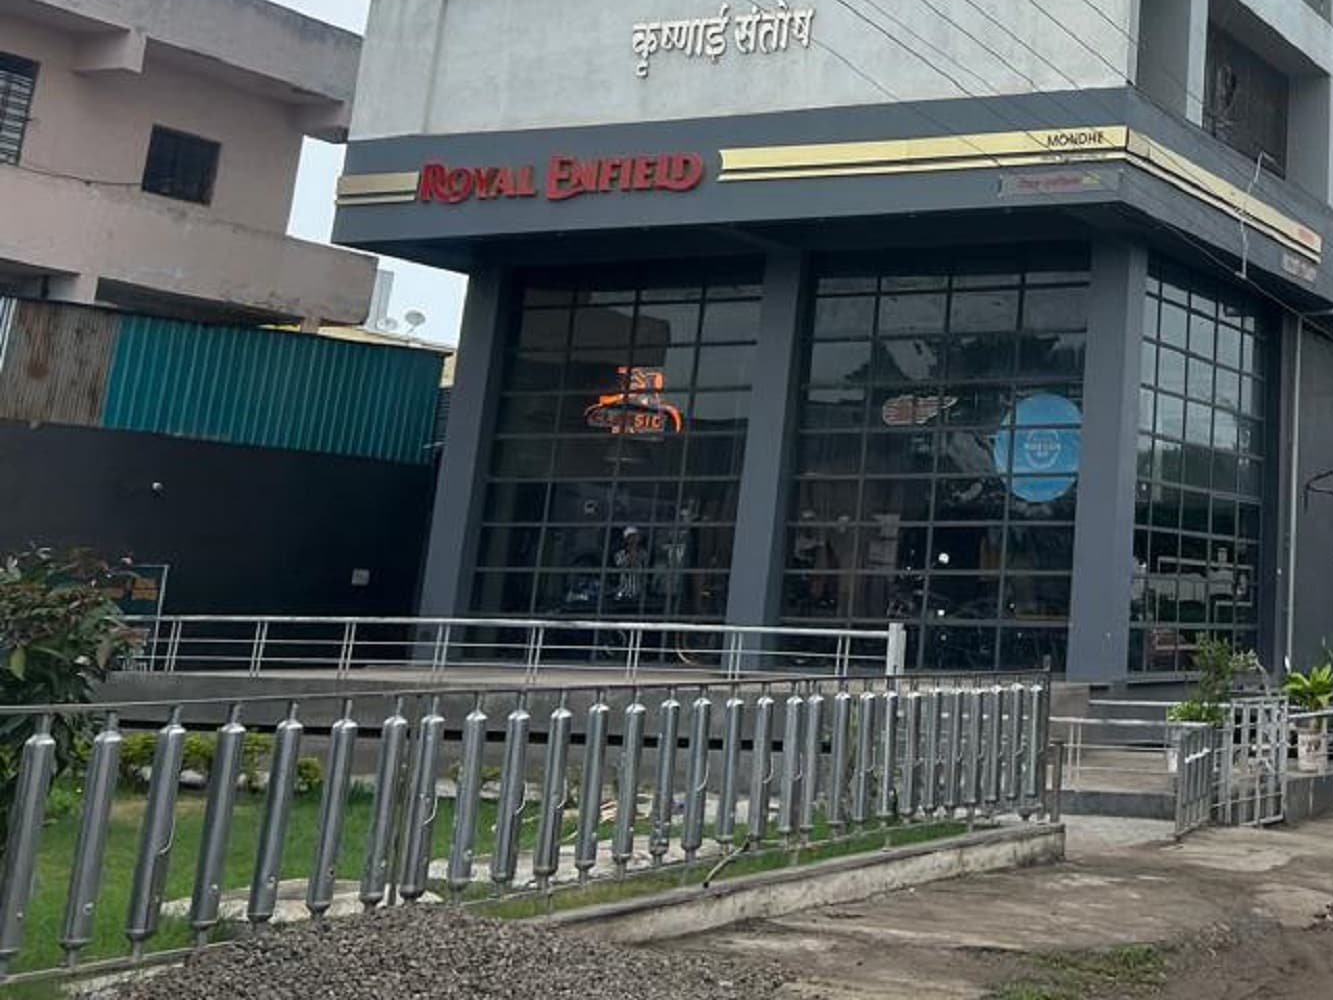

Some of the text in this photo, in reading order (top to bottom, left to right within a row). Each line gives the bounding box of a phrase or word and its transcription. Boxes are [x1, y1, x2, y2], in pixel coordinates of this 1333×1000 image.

[632, 0, 815, 78] कृष्णाई संतोष
[420, 152, 703, 203] ROYAL ENFIELD
